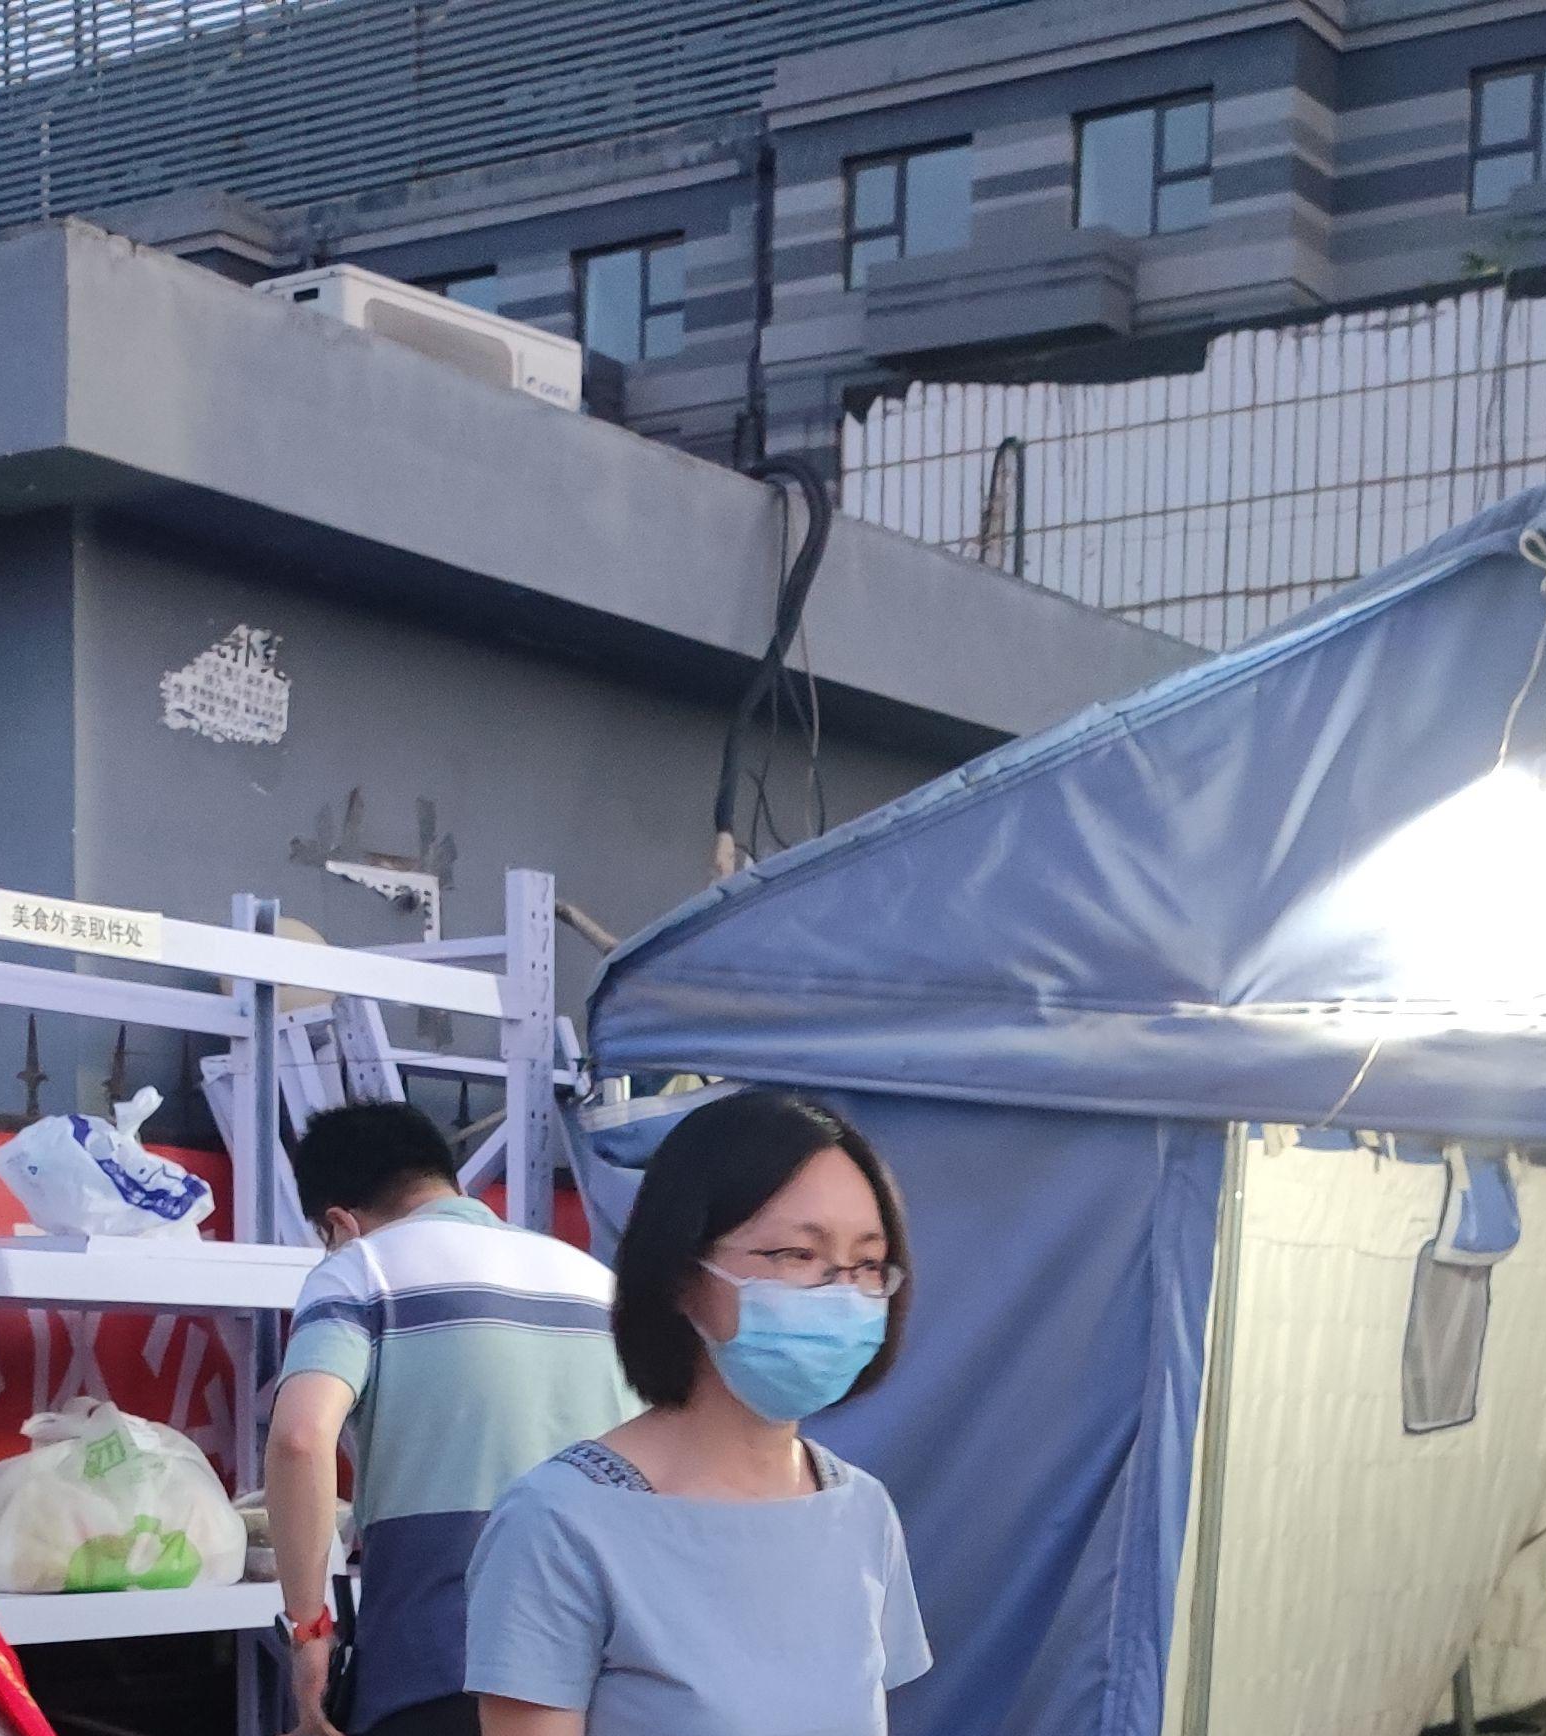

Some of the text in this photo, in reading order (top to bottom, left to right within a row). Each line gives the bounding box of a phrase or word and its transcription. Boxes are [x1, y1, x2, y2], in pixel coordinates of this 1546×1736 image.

[12, 904, 143, 947] 美食外卖取件处
